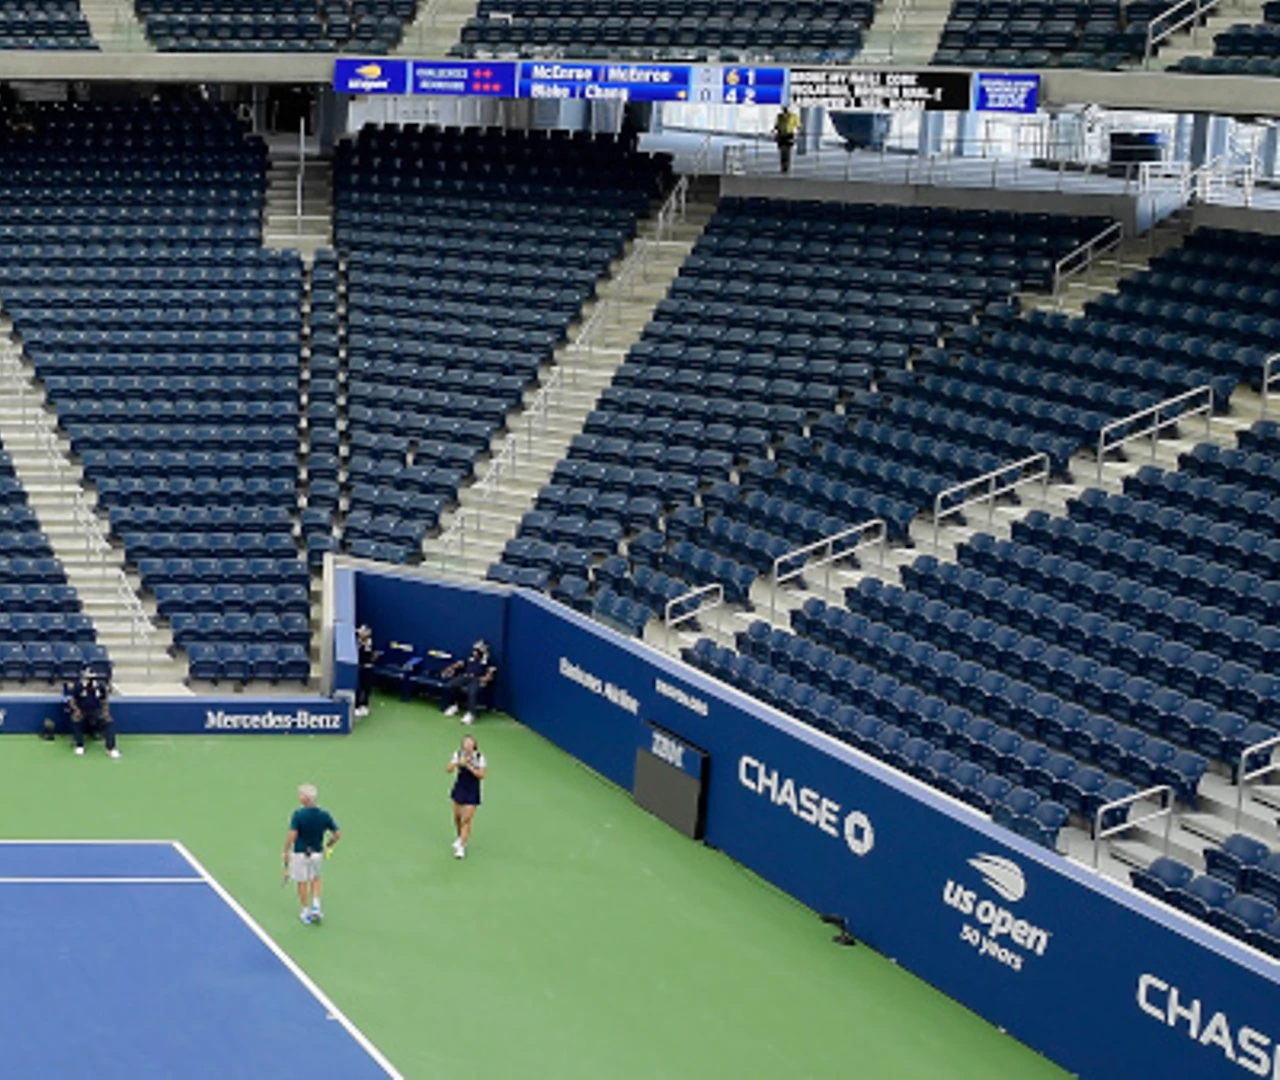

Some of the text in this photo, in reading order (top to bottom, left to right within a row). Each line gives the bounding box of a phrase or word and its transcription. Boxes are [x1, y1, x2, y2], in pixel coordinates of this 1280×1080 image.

[746, 69, 756, 86] 1
[204, 710, 341, 729] Mercedes-Benz
[652, 730, 685, 768] IBM
[738, 755, 840, 838] CHASE
[943, 878, 1048, 956] us open
[979, 935, 1024, 972] years
[1137, 973, 1280, 1080] CHAS
